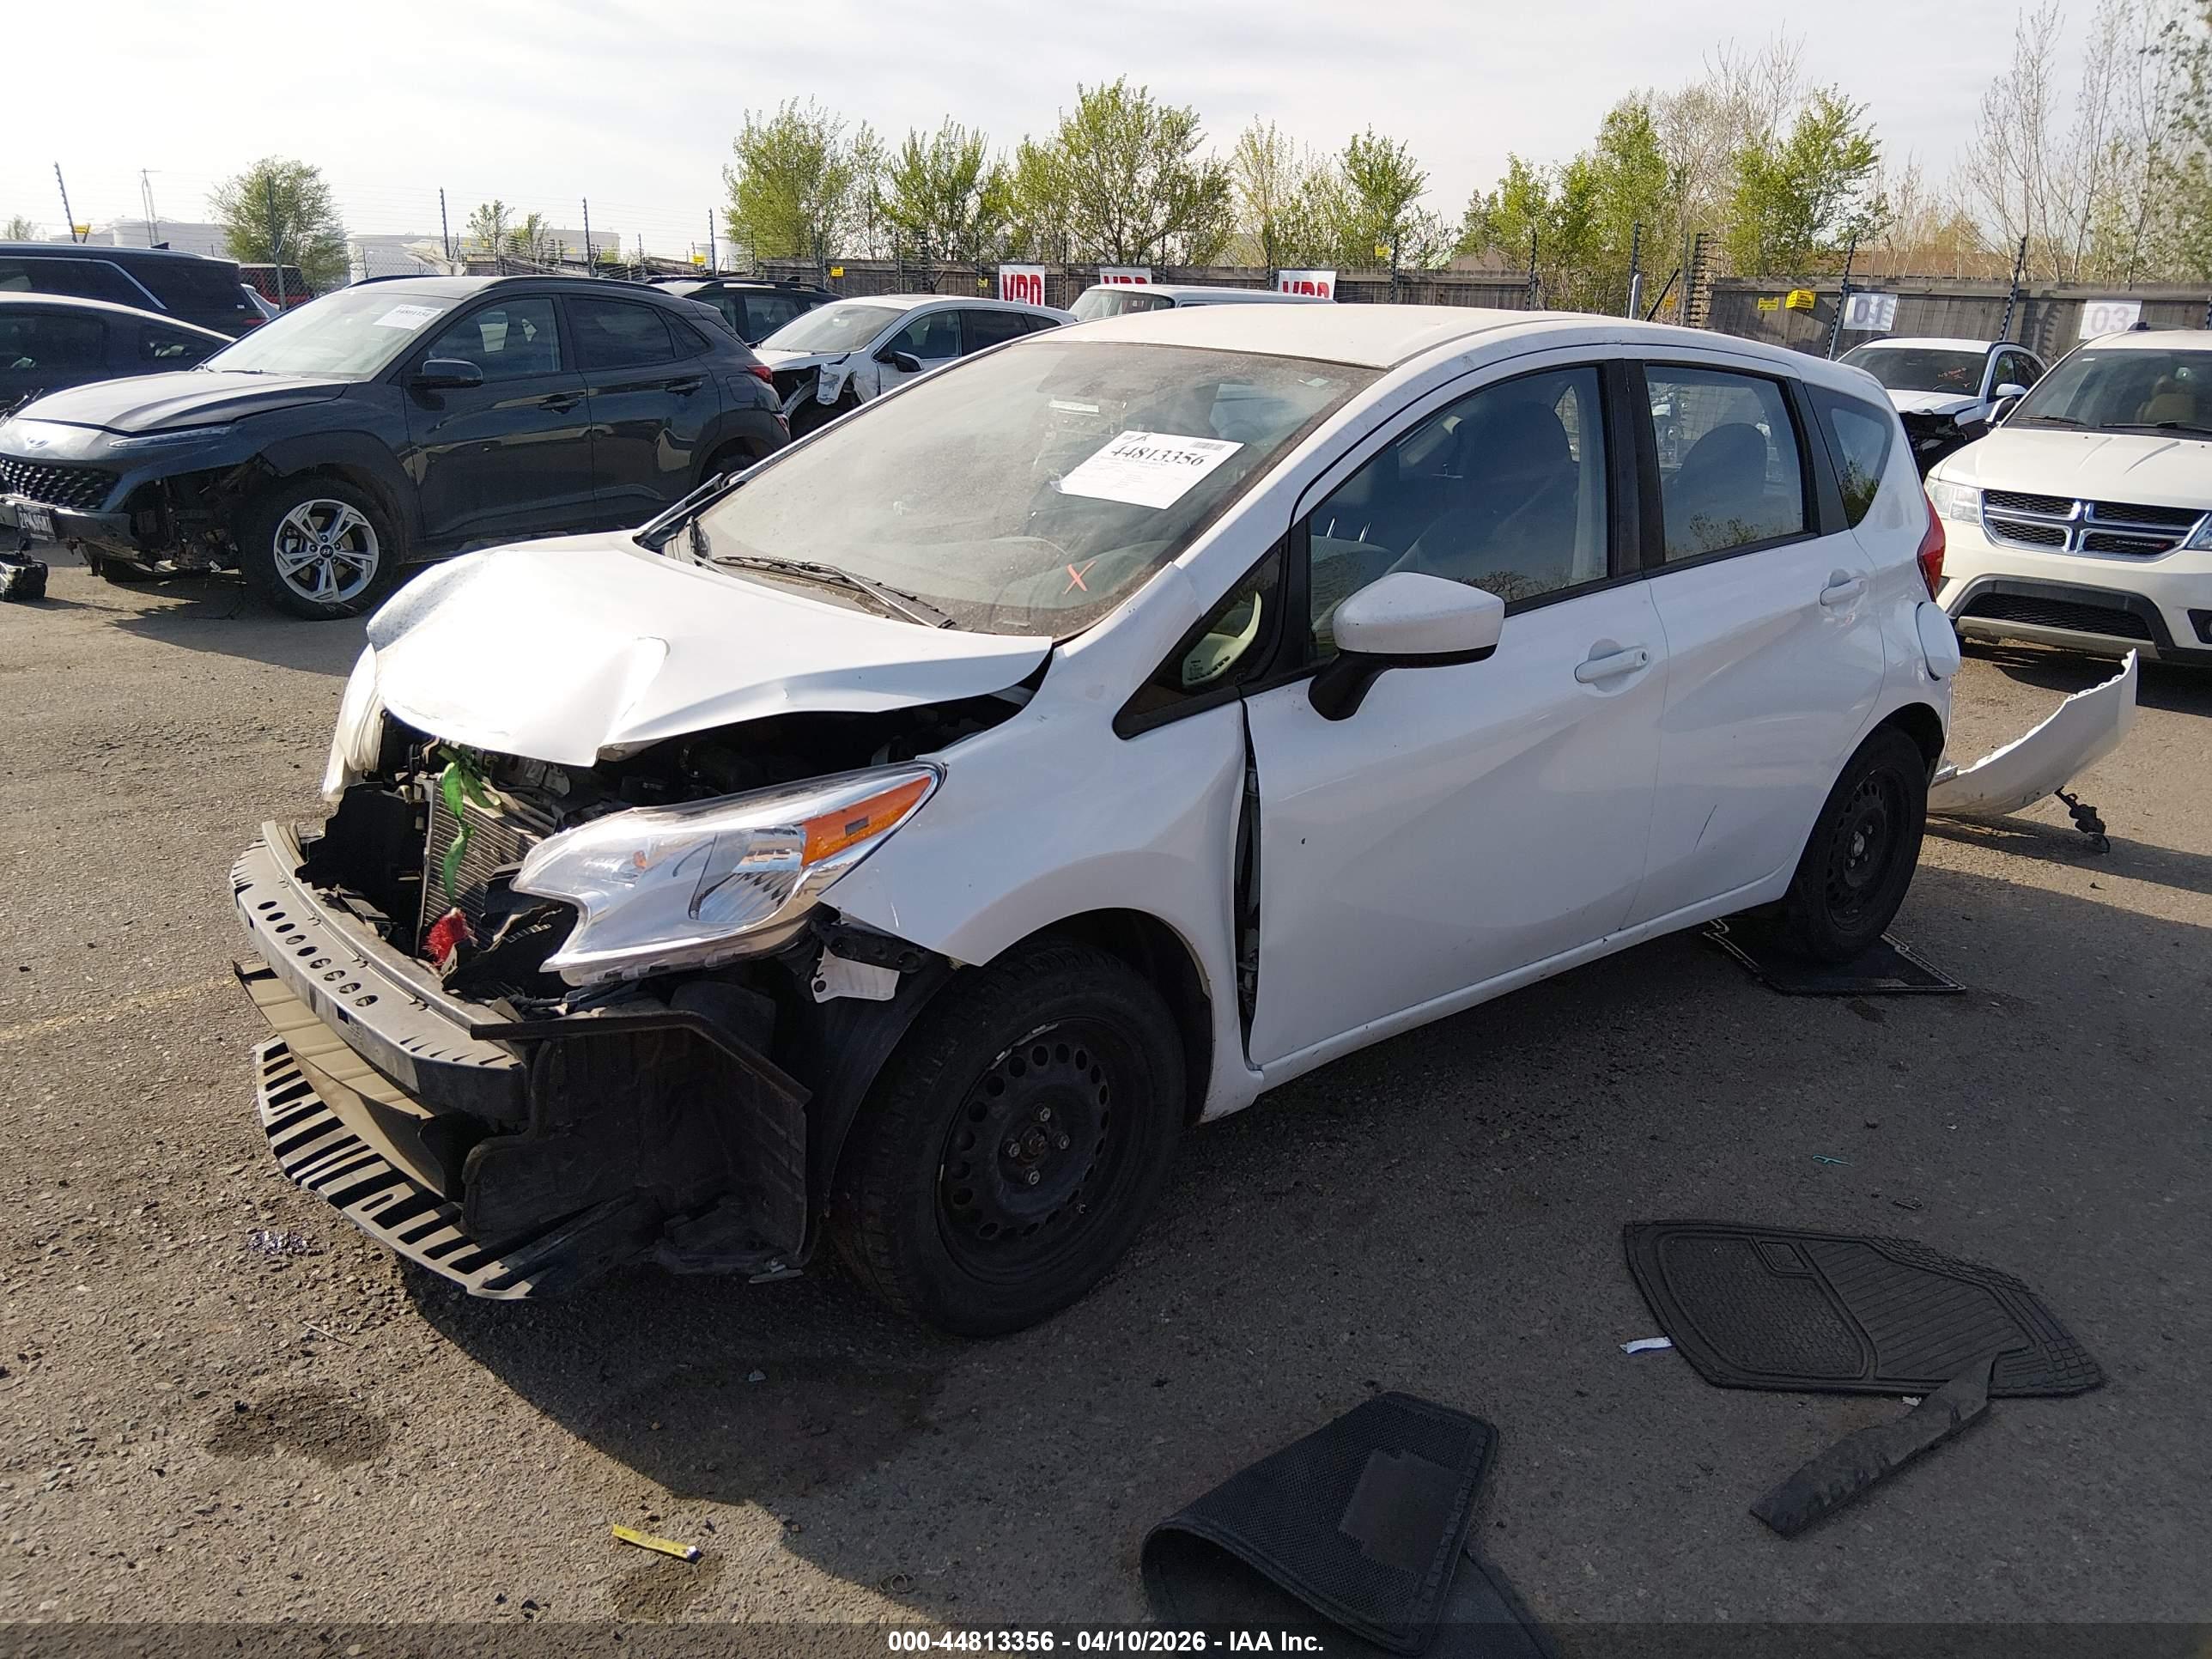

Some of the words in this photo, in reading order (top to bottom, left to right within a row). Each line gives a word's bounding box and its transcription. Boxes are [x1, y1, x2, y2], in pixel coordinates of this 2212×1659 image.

[1854, 299, 1884, 325] 01
[2091, 306, 2130, 333] 03
[1111, 445, 1209, 466] 44813356
